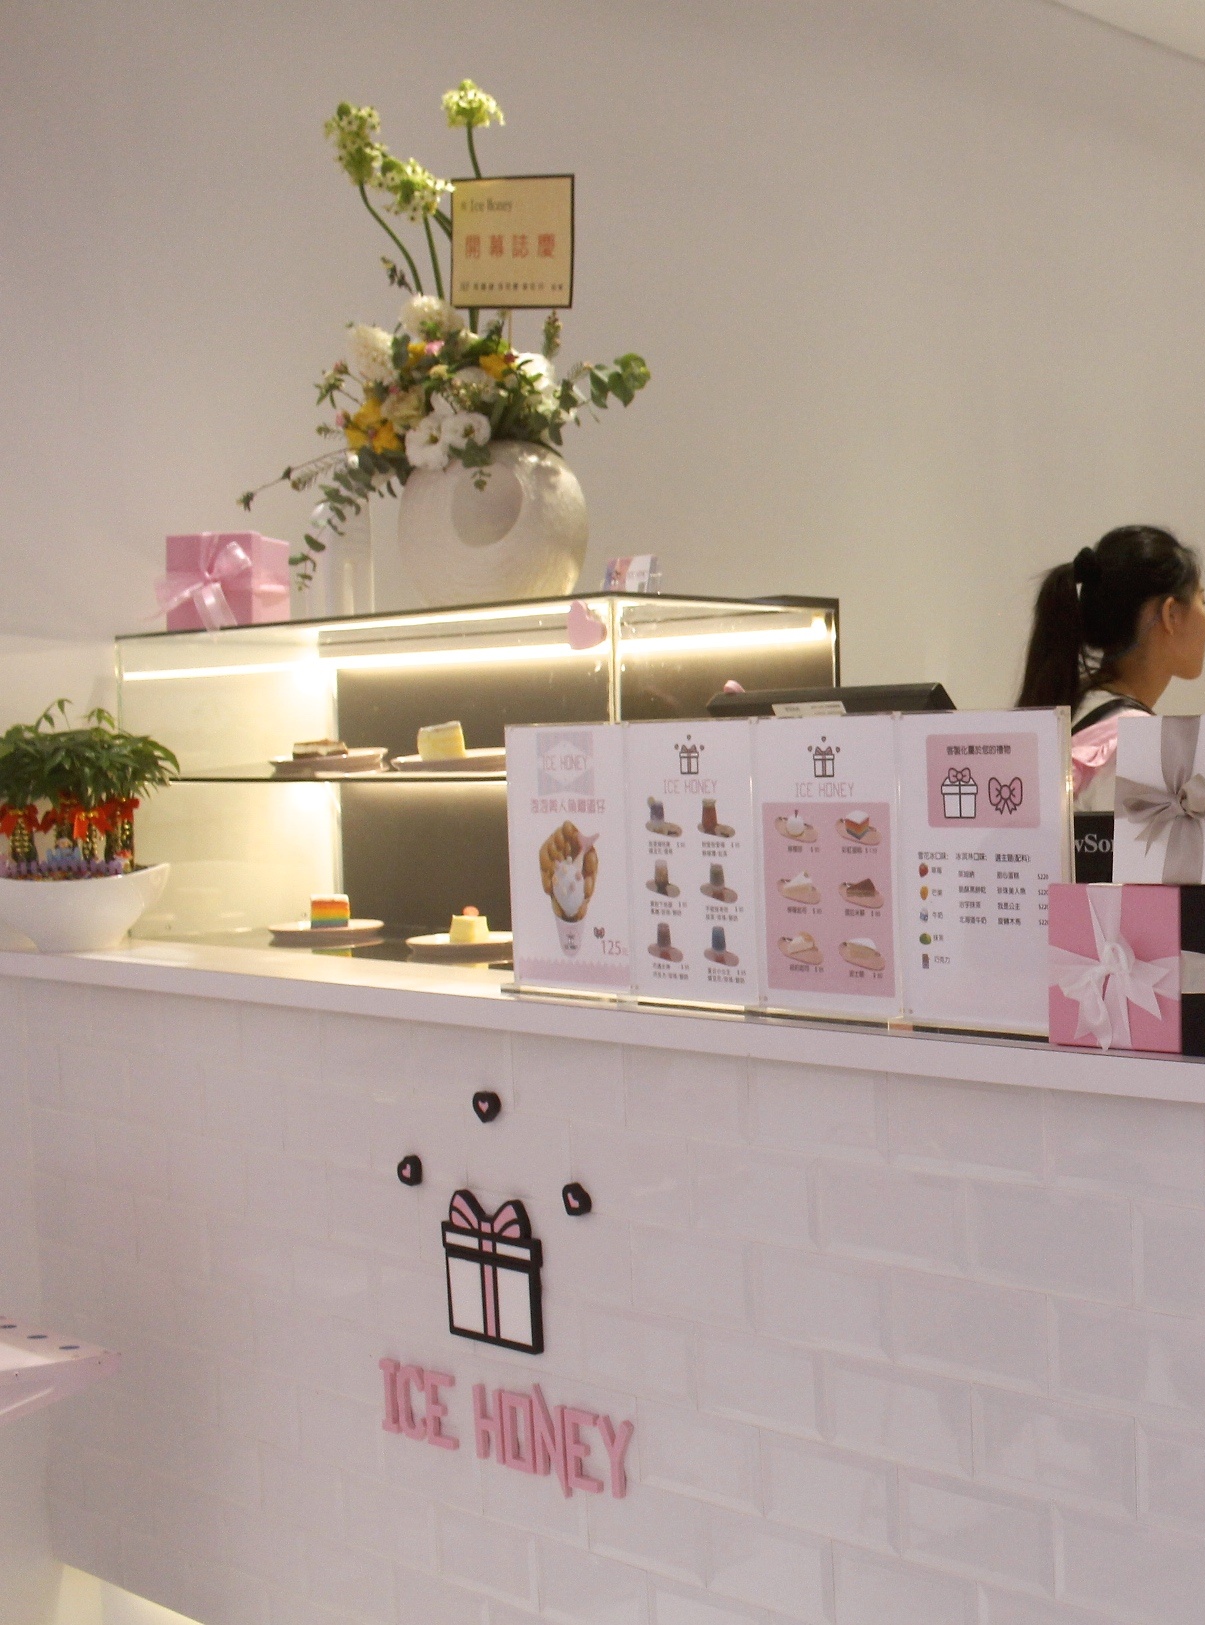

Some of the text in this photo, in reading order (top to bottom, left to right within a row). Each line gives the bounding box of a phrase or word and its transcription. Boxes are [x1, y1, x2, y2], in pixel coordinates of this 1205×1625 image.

[560, 753, 588, 771] HONEY
[663, 779, 718, 795] ICE HONEY
[795, 781, 855, 798] ICE HONEY
[378, 1357, 635, 1500] ICE HONEY
